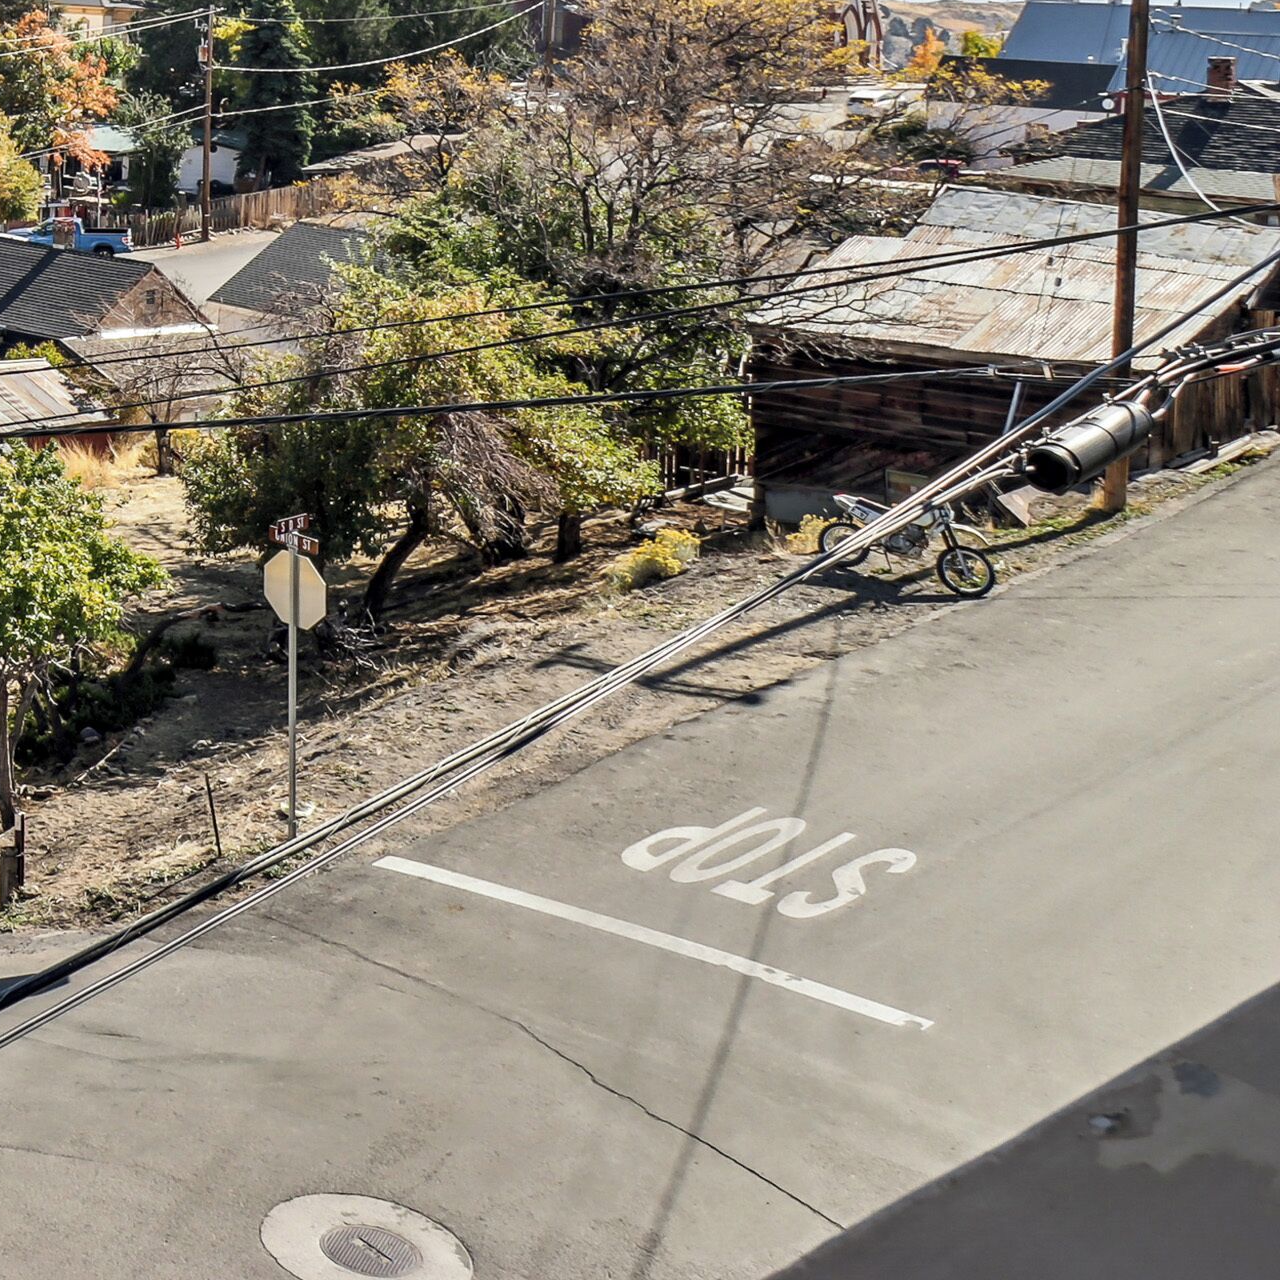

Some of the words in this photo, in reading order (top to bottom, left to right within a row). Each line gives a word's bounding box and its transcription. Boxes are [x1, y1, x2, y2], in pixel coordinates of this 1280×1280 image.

[281, 521, 286, 532] S
[297, 516, 304, 528] ST
[275, 529, 298, 546] UNION
[302, 538, 311, 551] ST
[621, 806, 918, 919] STOP
